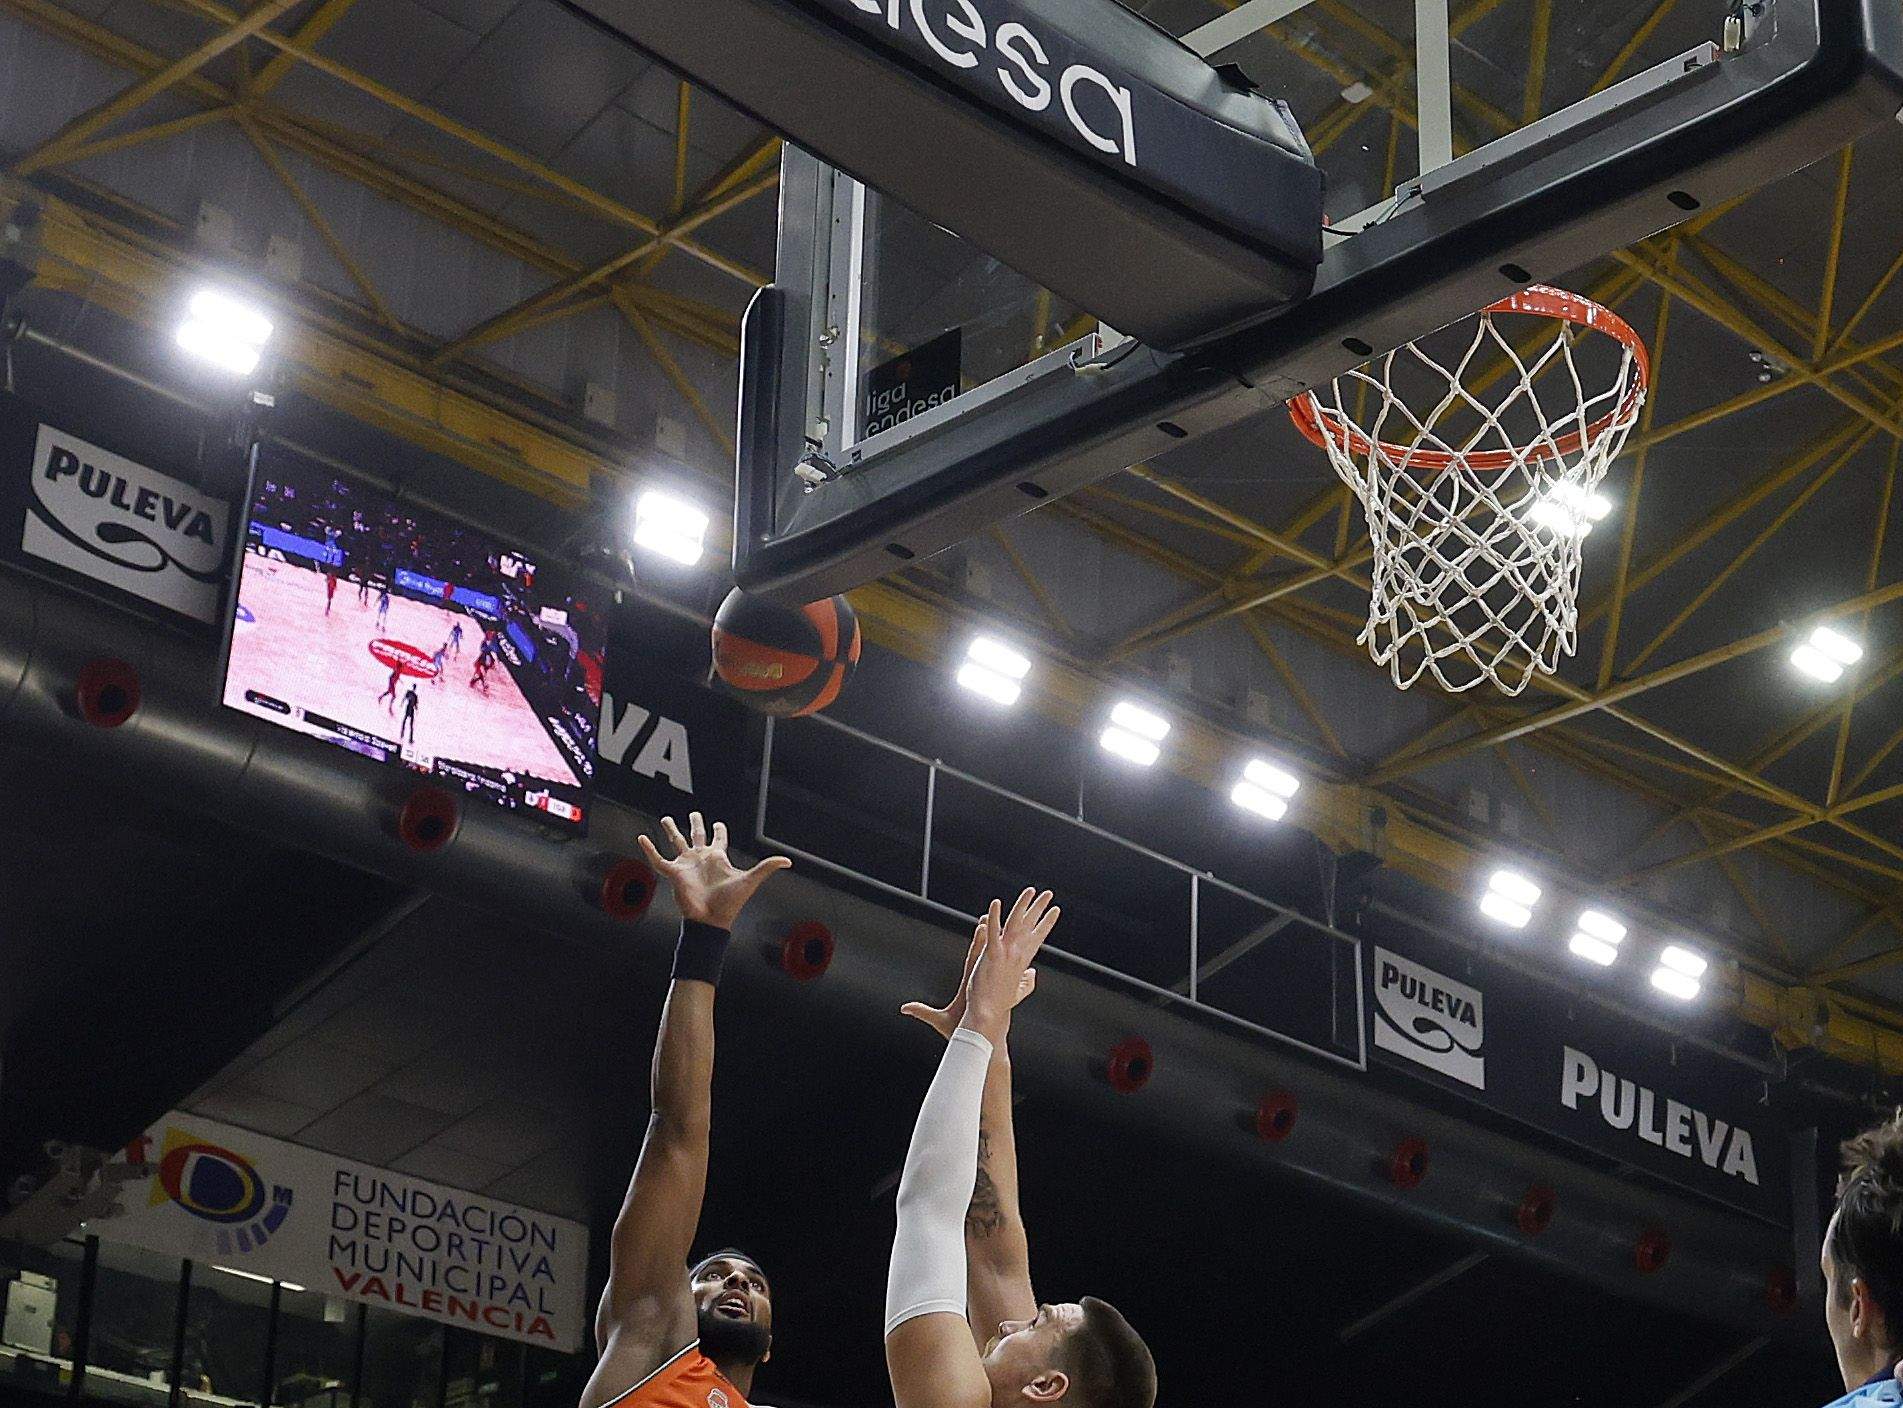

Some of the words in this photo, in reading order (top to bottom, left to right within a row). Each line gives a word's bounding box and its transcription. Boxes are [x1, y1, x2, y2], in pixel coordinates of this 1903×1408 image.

[866, 382, 907, 417] liga
[44, 443, 215, 546] PULEVA
[1380, 959, 1477, 1029] PULEVA
[1560, 1044, 1760, 1186] PULEVA
[331, 1201, 556, 1284] DEPORTIVA
[333, 1170, 556, 1252] FUNDACIÓN
[328, 1234, 555, 1316] MUNICIPAL
[332, 1267, 556, 1341] VALENCIA
